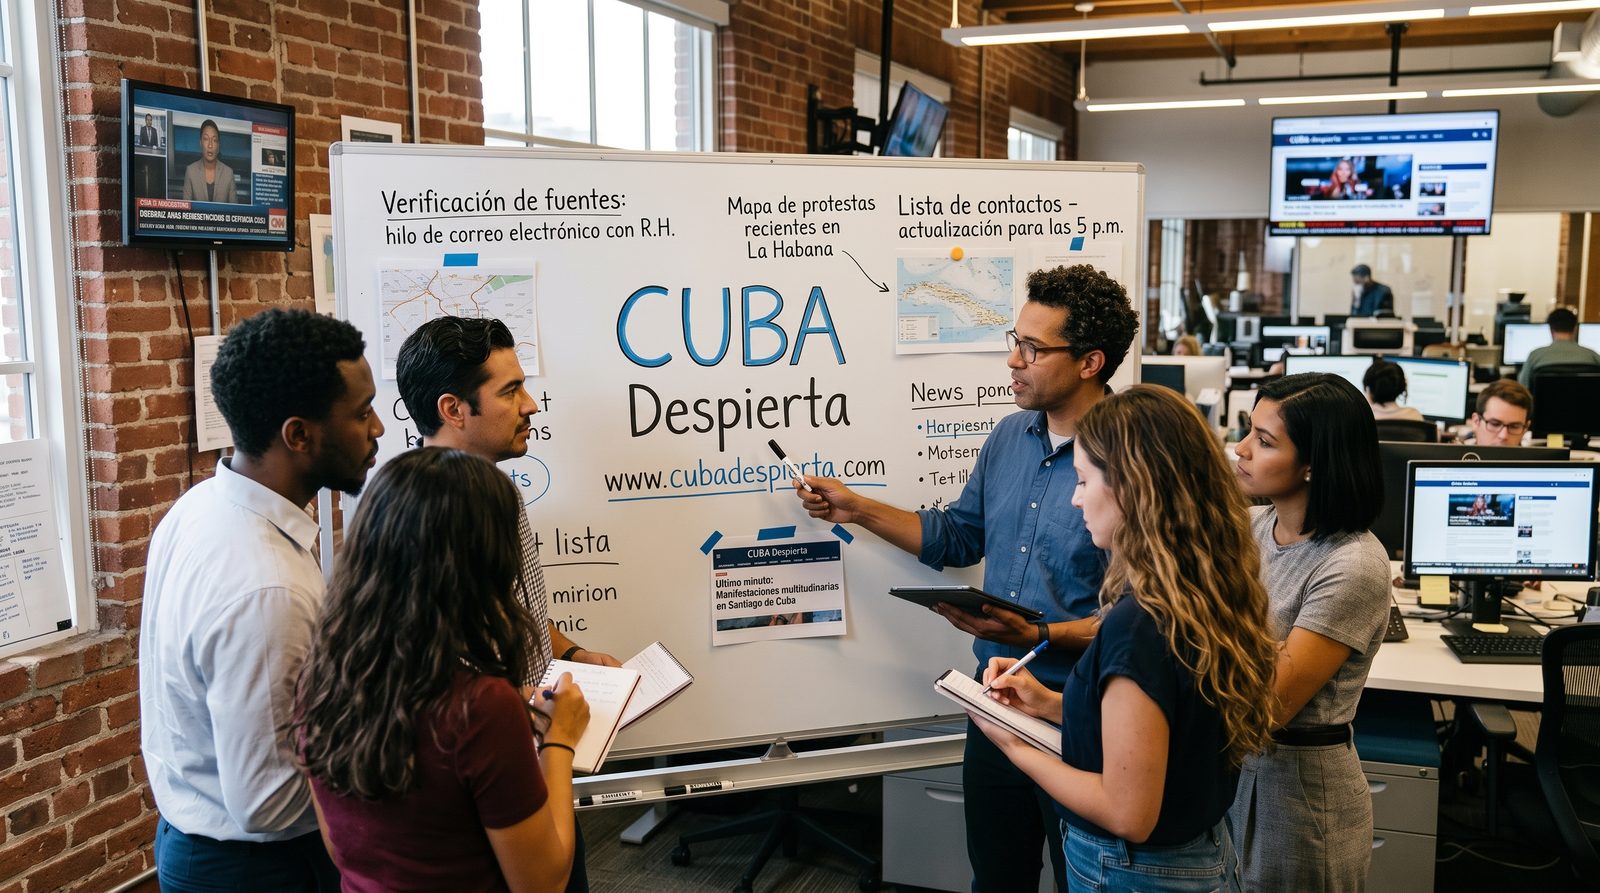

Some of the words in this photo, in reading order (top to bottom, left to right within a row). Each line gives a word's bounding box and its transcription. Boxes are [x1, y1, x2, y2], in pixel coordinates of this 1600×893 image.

[381, 188, 506, 214] Verificación
[513, 188, 538, 212] de
[545, 187, 626, 211] fuentes:
[727, 196, 773, 220] Mapa
[777, 195, 797, 214] de
[802, 194, 876, 218] protestas
[898, 194, 944, 216] Lista
[949, 193, 972, 215] de
[977, 193, 1063, 215] contactos
[385, 225, 417, 245] hilo
[423, 224, 444, 244] de
[449, 228, 504, 243] correo
[509, 221, 601, 242] electrónico
[606, 225, 635, 239] con
[640, 217, 676, 238] R.H.
[744, 219, 817, 237] recientes
[822, 221, 841, 235] en
[898, 219, 1003, 239] actualización
[1008, 223, 1044, 242] para
[1049, 217, 1072, 235] las
[1077, 216, 1087, 235] 5
[1092, 220, 1124, 240] p.m.
[747, 241, 768, 259] La
[773, 239, 834, 259] Habana
[616, 284, 847, 368] CUBA
[911, 381, 964, 403] News
[628, 376, 851, 453] Despierta
[555, 526, 611, 556] lista
[747, 548, 770, 558] CUBA
[772, 546, 808, 558] Despierta
[716, 588, 780, 599] Manifestaciones
[781, 582, 840, 594] multitudinarias
[743, 576, 774, 586] minuto:
[553, 583, 617, 604] mirion
[716, 602, 727, 610] en
[728, 599, 763, 610] Santiago
[764, 598, 774, 607] de
[776, 596, 796, 606] Cuba
